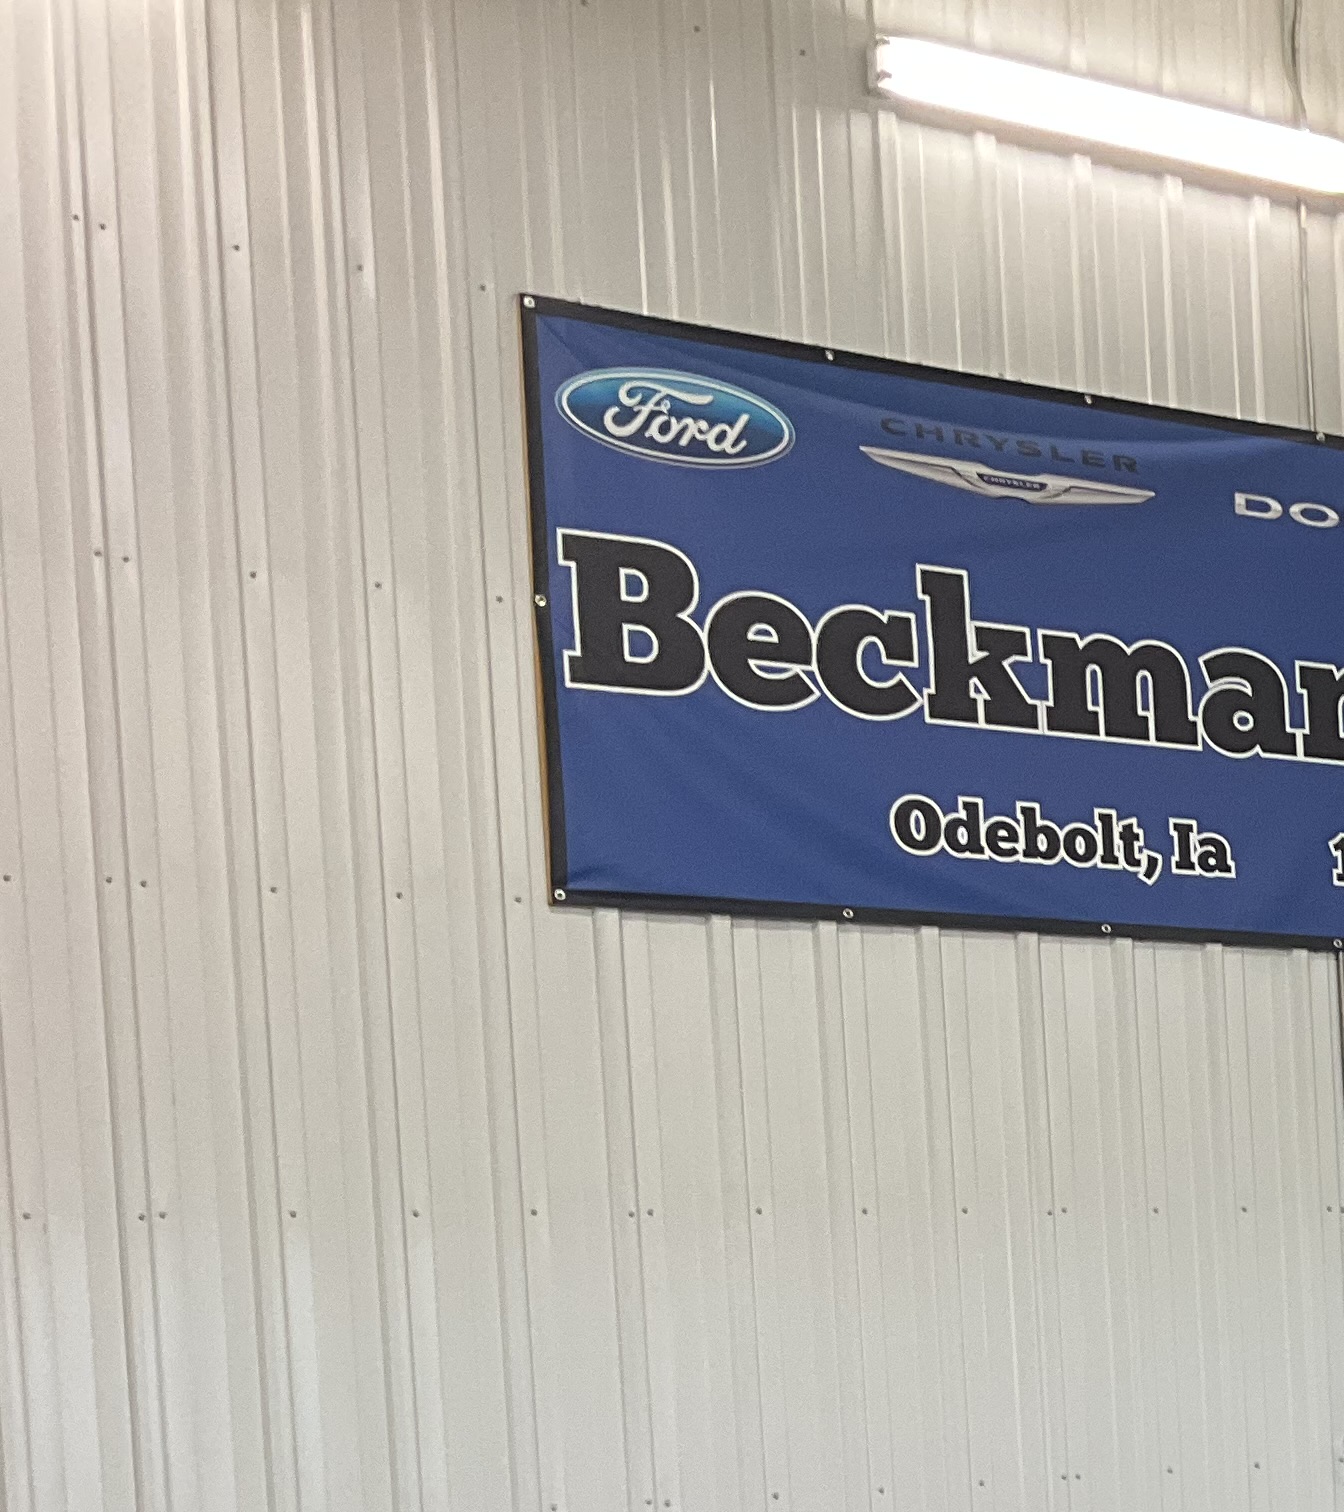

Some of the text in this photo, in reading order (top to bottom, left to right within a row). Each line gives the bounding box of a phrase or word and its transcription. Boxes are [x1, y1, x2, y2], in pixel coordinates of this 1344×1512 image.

[603, 381, 748, 456] Ford
[880, 417, 1138, 473] CHRYSLER
[889, 794, 1236, 886] Odebolt, Ia
